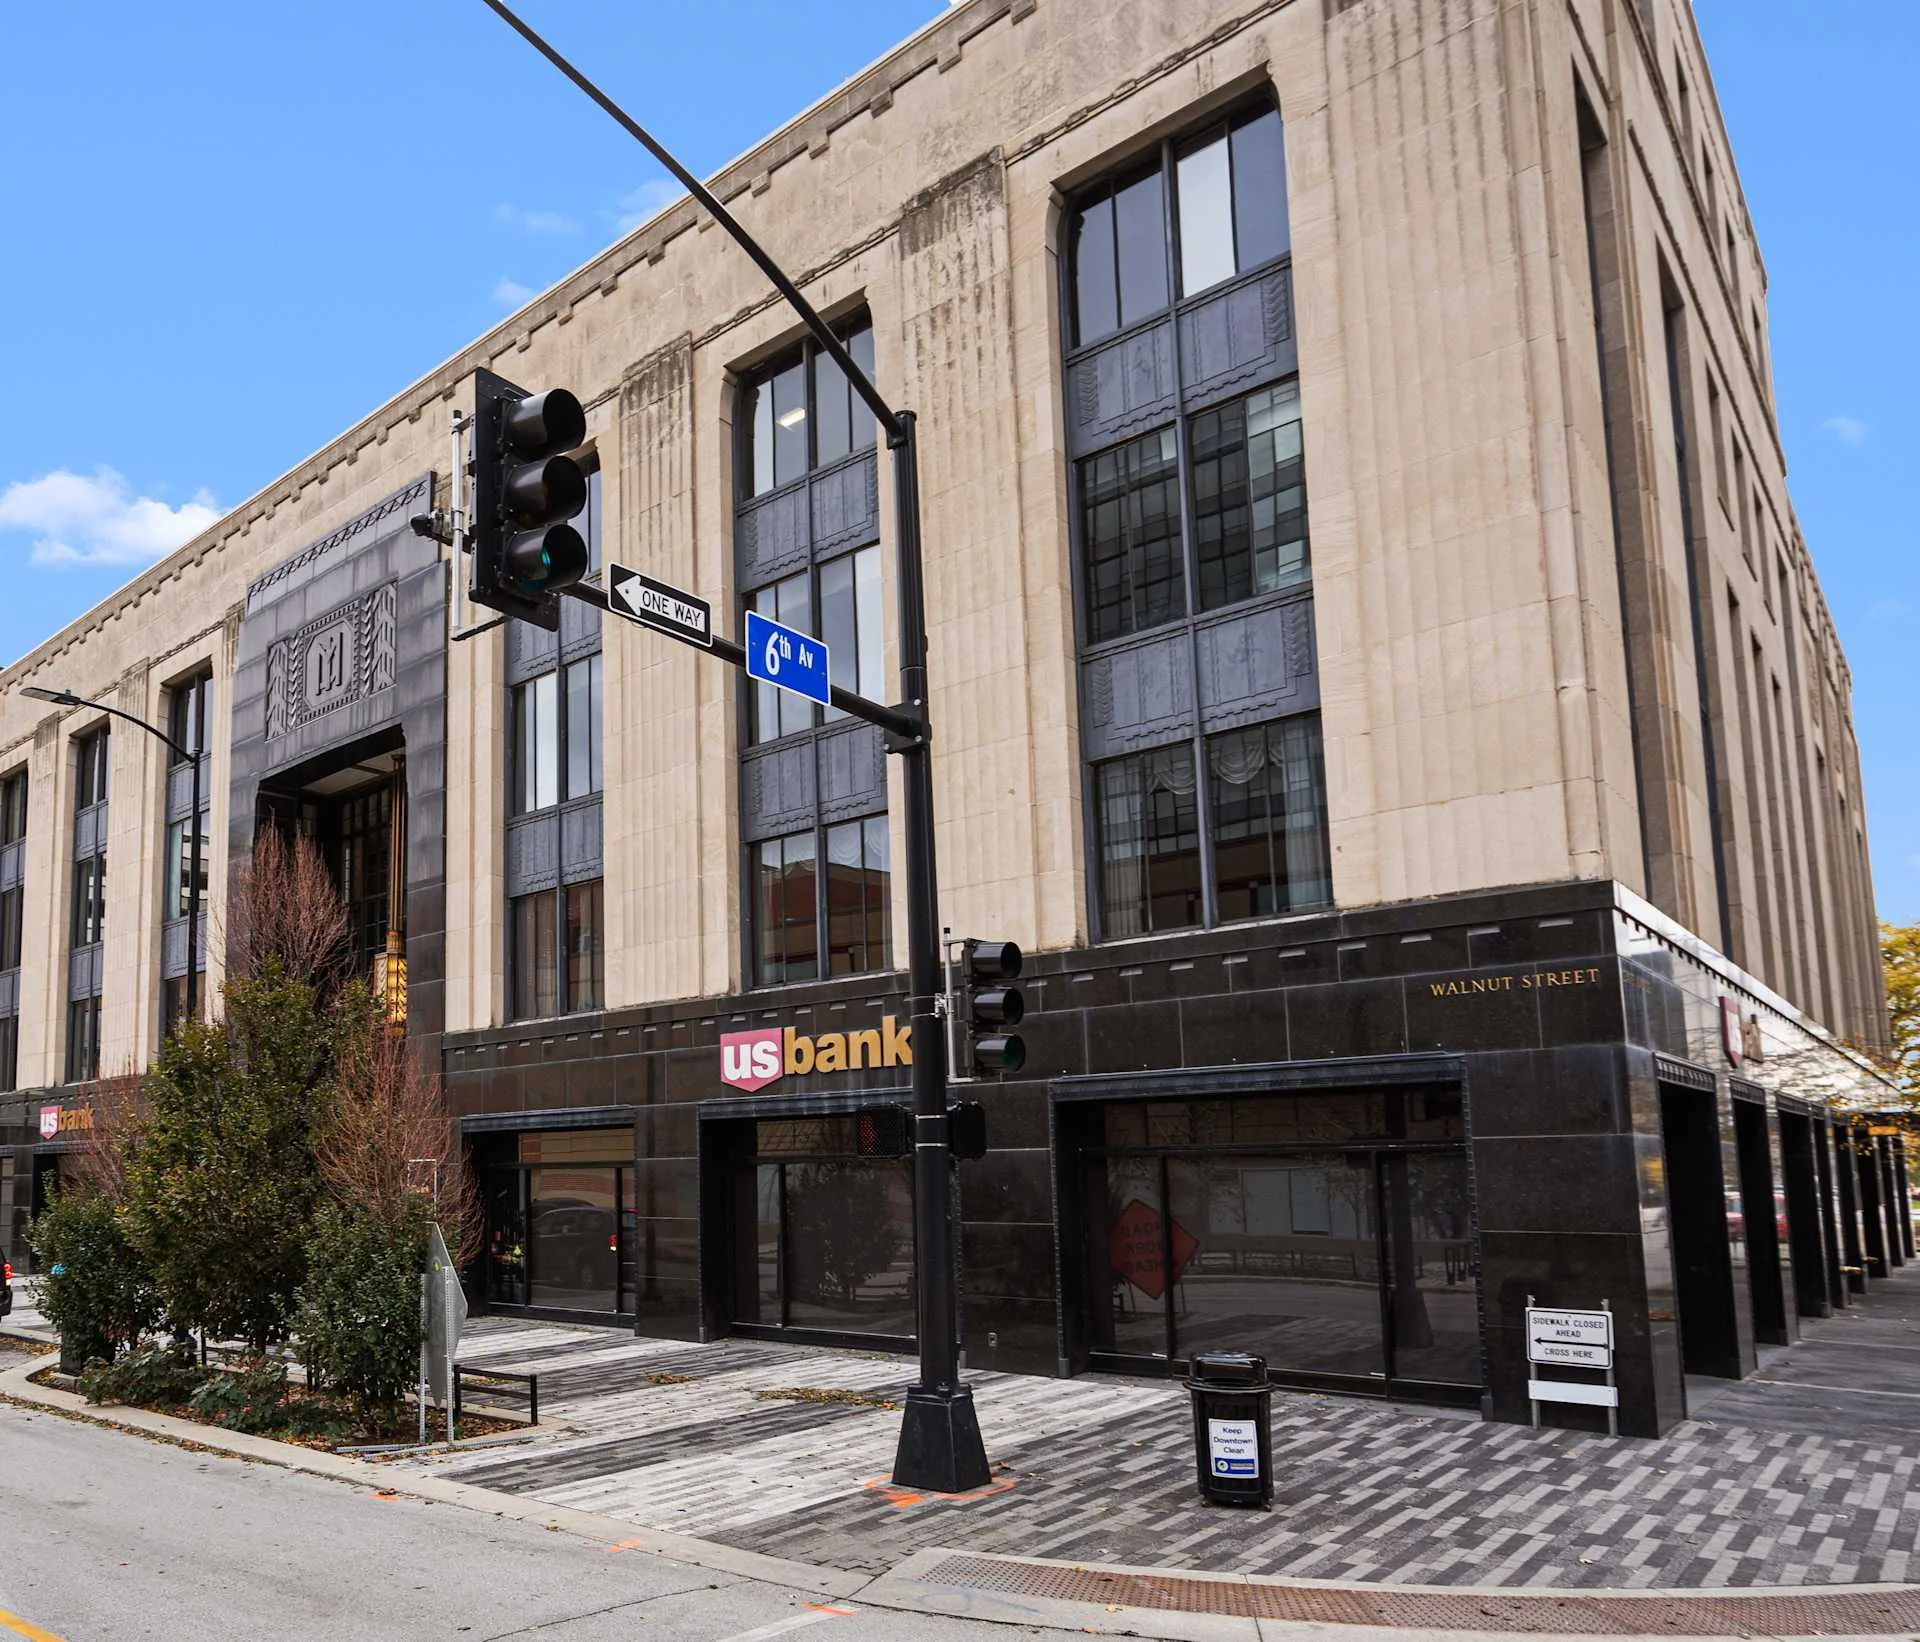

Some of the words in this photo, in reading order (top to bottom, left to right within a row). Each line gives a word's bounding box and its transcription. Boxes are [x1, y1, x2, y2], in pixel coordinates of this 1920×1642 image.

[642, 590, 669, 615] ONE
[674, 602, 702, 628] WAY
[765, 631, 791, 676] 6th
[798, 644, 814, 669] Av
[1430, 976, 1513, 997] WALNUT
[1521, 968, 1600, 989] STREET
[1532, 1317, 1570, 1327] SIDEWALK
[1573, 1319, 1604, 1329] CLOSED
[1555, 1329, 1581, 1338] AHEAD
[1544, 1348, 1570, 1357] CROSS
[1573, 1350, 1594, 1359] HERE
[1222, 1427, 1242, 1435] Keep
[1213, 1436, 1253, 1444] Downtown
[1223, 1446, 1245, 1454] Clean
